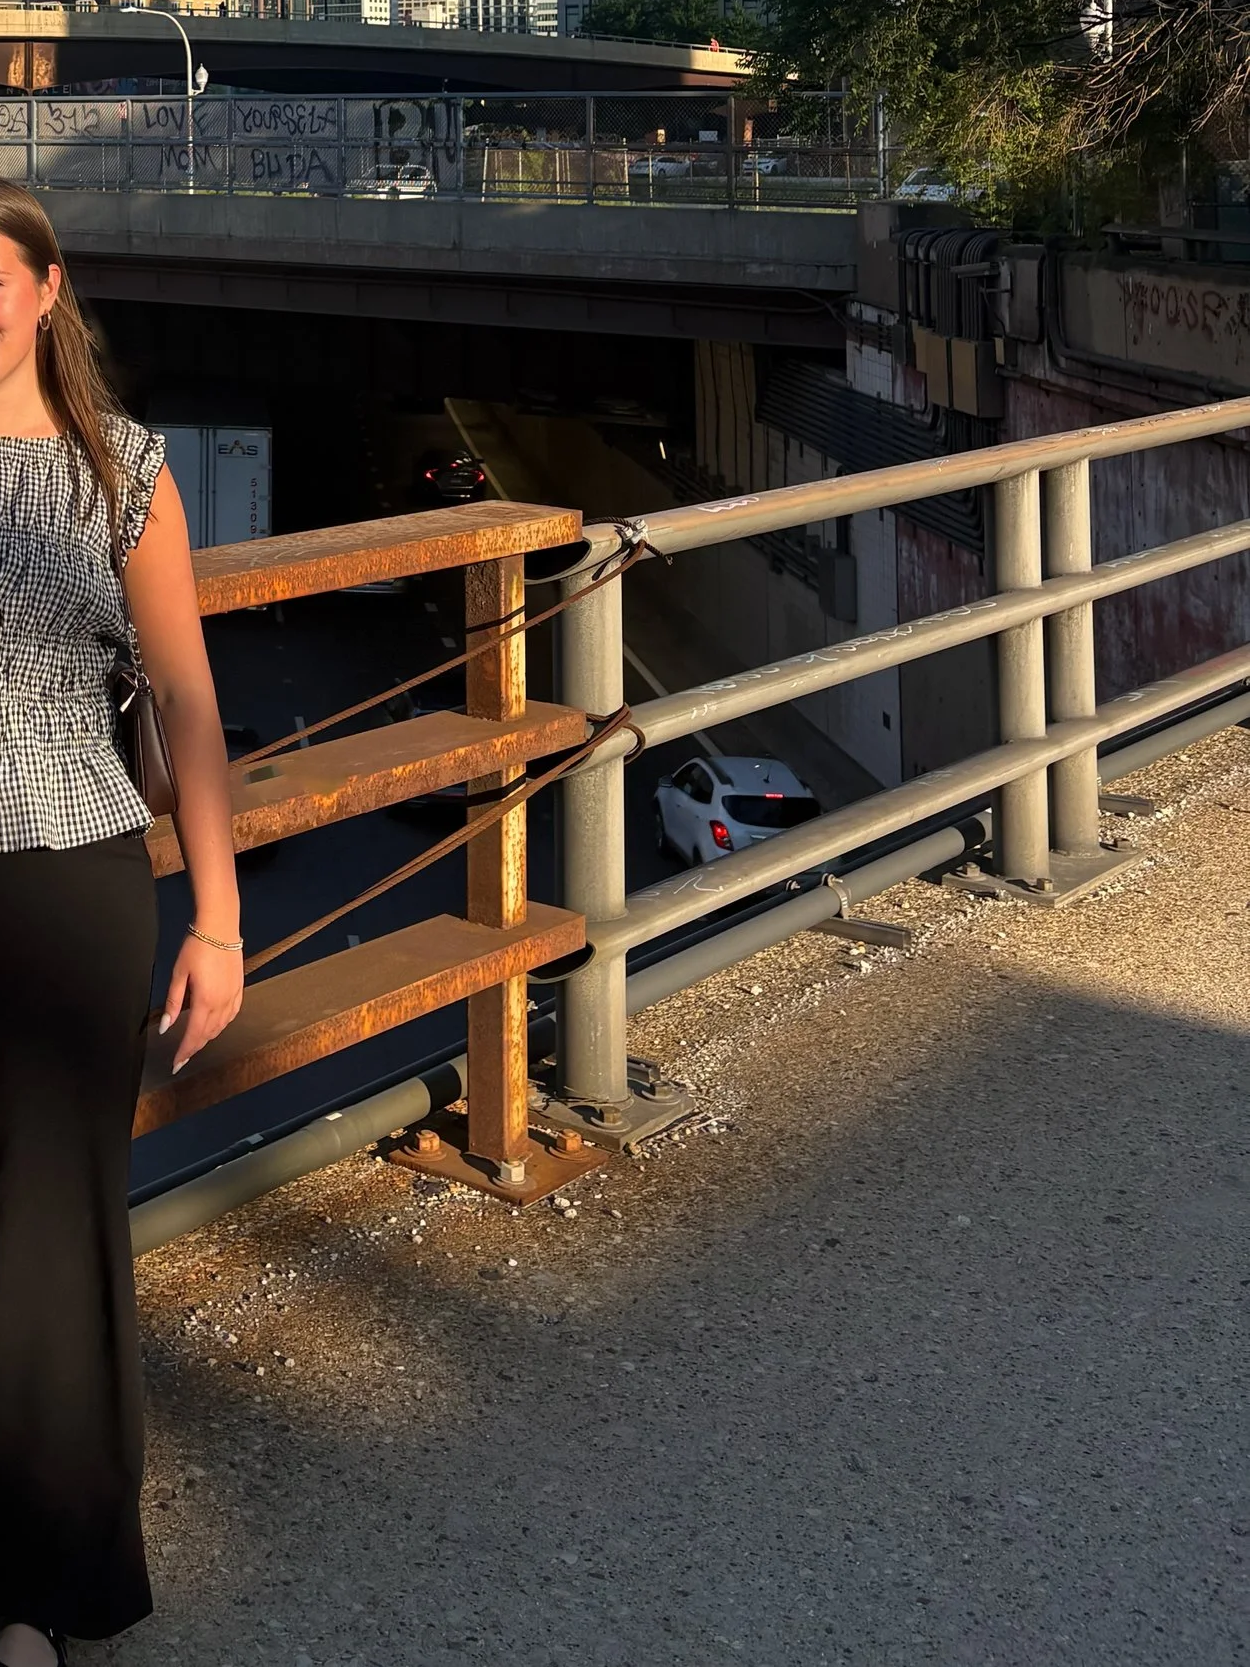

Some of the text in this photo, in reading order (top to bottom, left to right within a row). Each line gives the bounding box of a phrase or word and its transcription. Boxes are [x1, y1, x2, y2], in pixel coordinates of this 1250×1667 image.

[143, 103, 208, 135] LOVE
[160, 146, 334, 183] MOM BUDA
